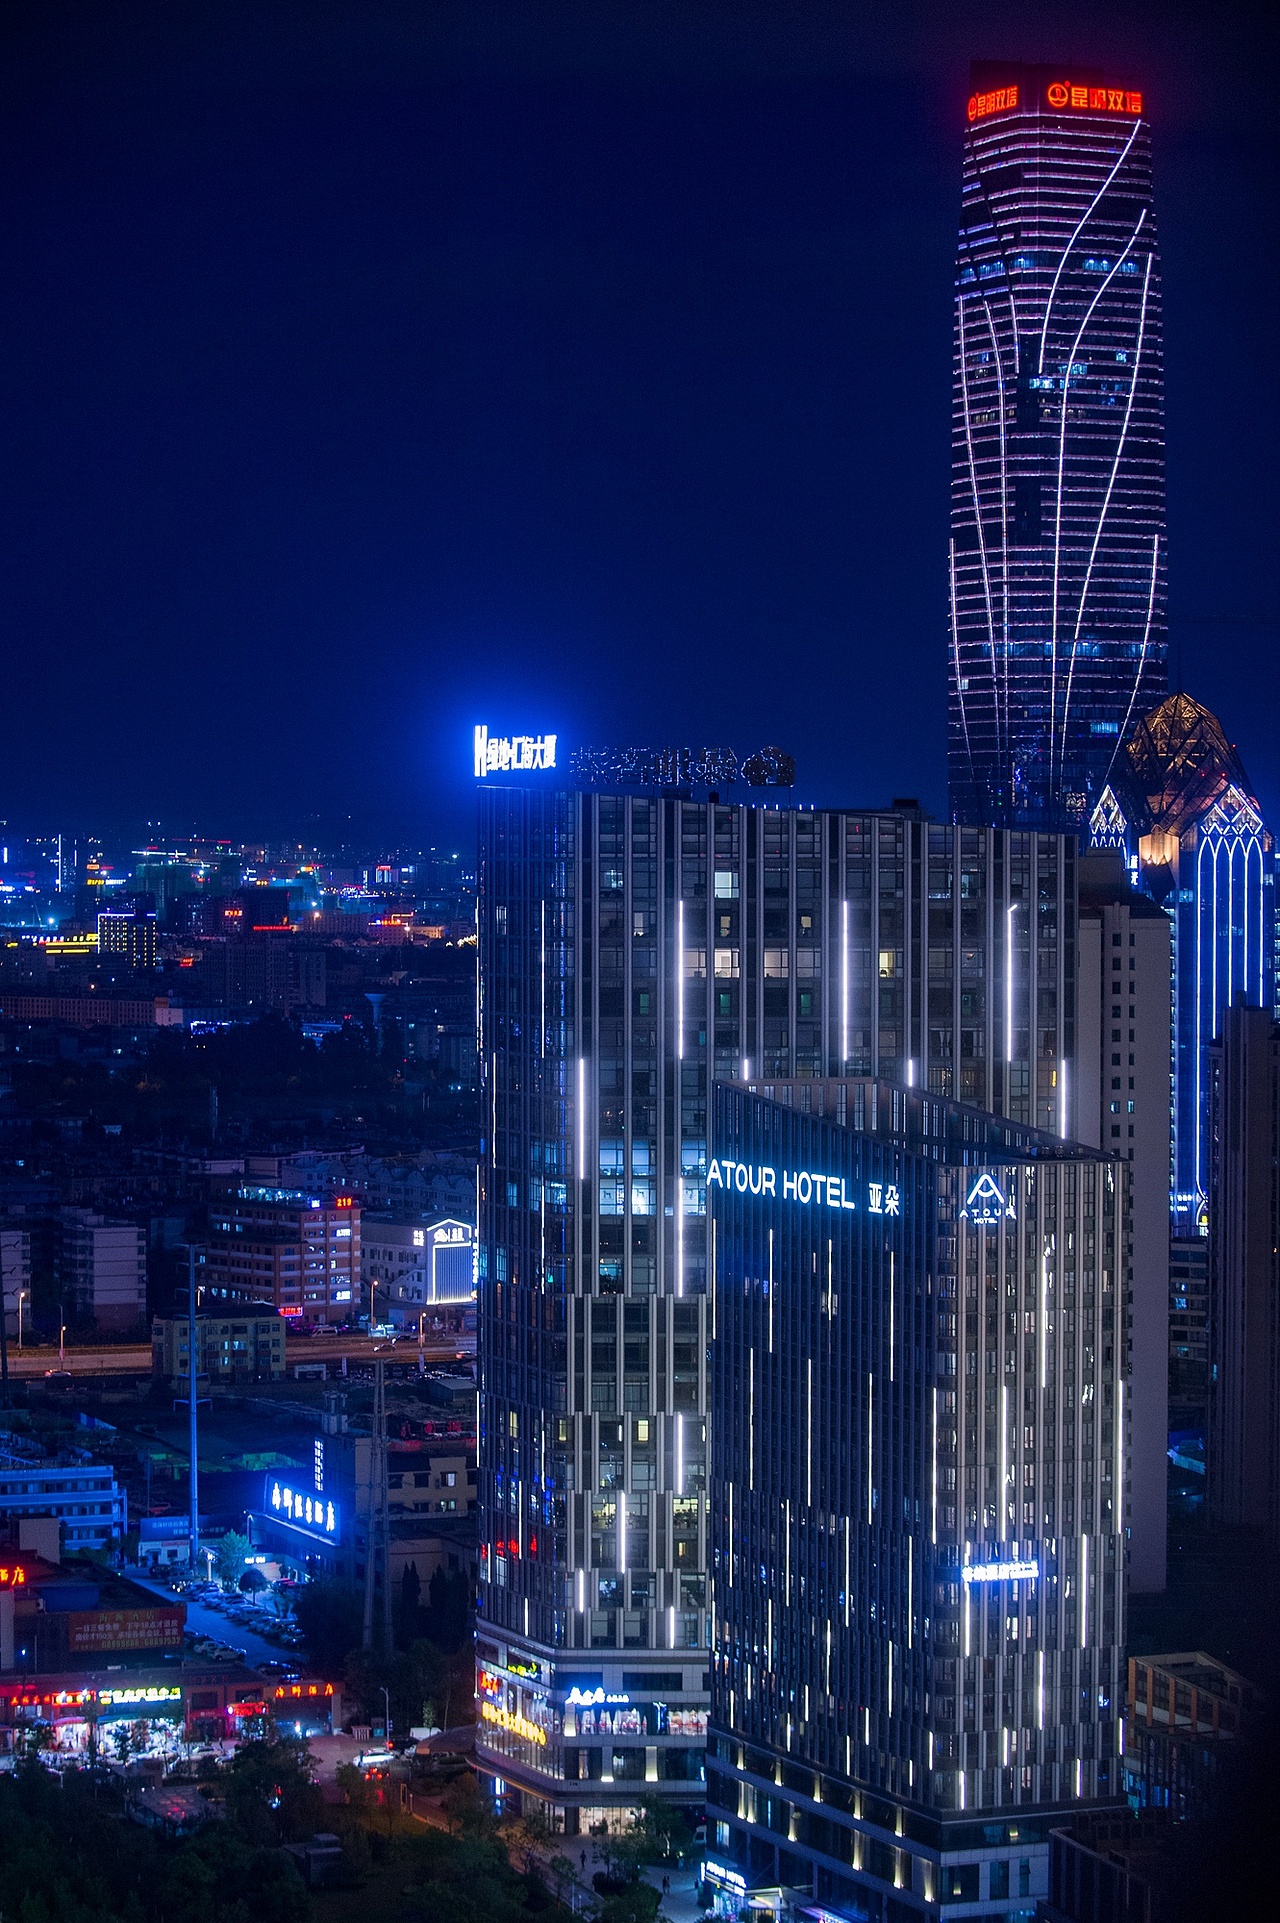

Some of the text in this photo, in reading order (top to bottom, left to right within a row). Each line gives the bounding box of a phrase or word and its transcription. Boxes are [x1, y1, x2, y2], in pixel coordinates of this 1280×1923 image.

[977, 85, 1018, 117] 昆明双塔
[1071, 87, 1142, 113] 昆明双塔
[706, 1158, 900, 1217] ATOUR HOTEL 亚朵
[960, 1208, 1014, 1219] ATOUR
